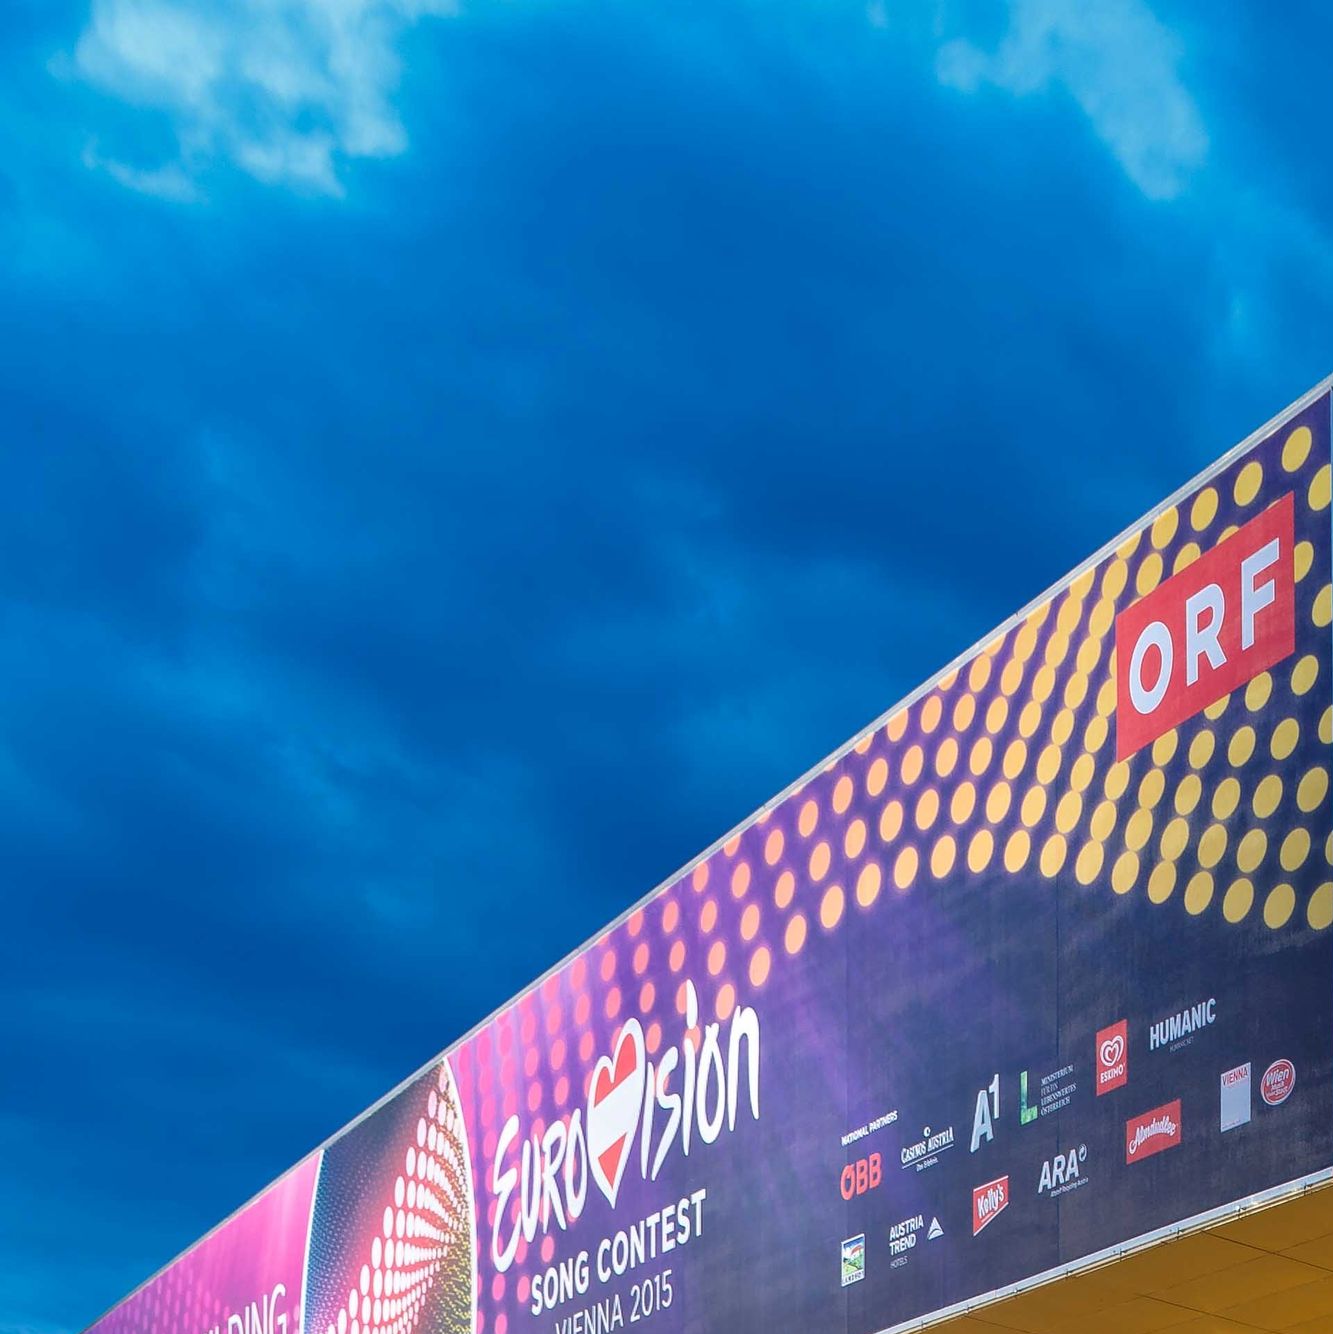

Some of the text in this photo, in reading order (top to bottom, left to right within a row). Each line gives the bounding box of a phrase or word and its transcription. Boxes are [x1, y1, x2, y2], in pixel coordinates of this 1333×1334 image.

[1129, 537, 1280, 714] ORF
[1149, 998, 1216, 1051] HUMANIC
[1100, 1065, 1124, 1084] ESKIMO
[1222, 1065, 1249, 1086] VIENNA
[1266, 1068, 1290, 1086] Wien
[841, 1110, 898, 1146] NATIONAL PARTNERS
[970, 1073, 1000, 1153] A1
[927, 1126, 954, 1152] AUSTRIA
[1129, 1115, 1177, 1155] Almdudler
[1038, 1148, 1080, 1194] ARA
[977, 1183, 1005, 1218] Kelly's
[889, 1214, 924, 1241] AUSTRIA
[889, 1233, 917, 1256] TREND
[531, 1189, 706, 1316] SONG CONTEST
[630, 1269, 673, 1323] 2015
